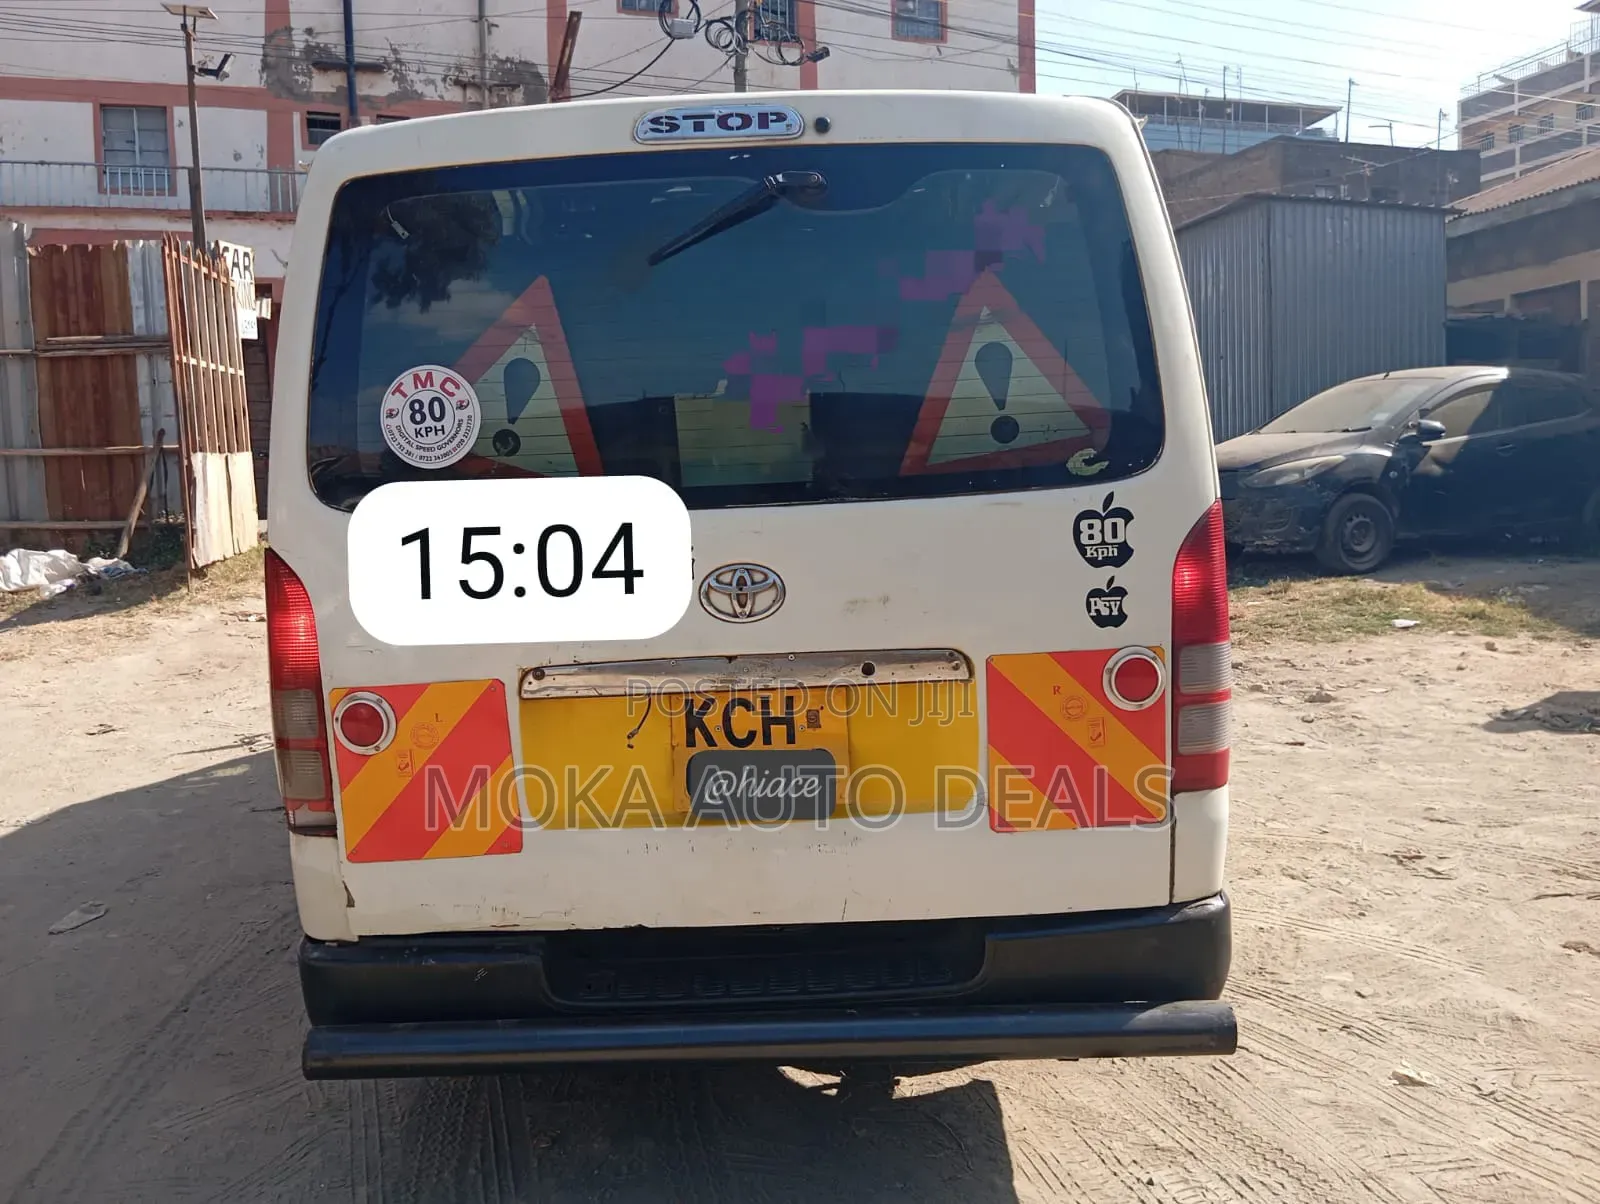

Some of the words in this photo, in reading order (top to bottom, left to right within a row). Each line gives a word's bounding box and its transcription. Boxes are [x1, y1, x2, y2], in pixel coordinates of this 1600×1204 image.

[649, 112, 788, 134] STOP
[391, 371, 460, 399] TMC
[409, 396, 446, 425] 80
[395, 425, 415, 448] DIGITAL
[415, 444, 436, 453] SPEED
[436, 418, 464, 451] GOVERNORS
[414, 424, 446, 439] KPH
[1080, 517, 1125, 545] 80
[1084, 544, 1119, 560] Kph
[1052, 685, 1062, 696] R
[684, 695, 796, 748] KCH
